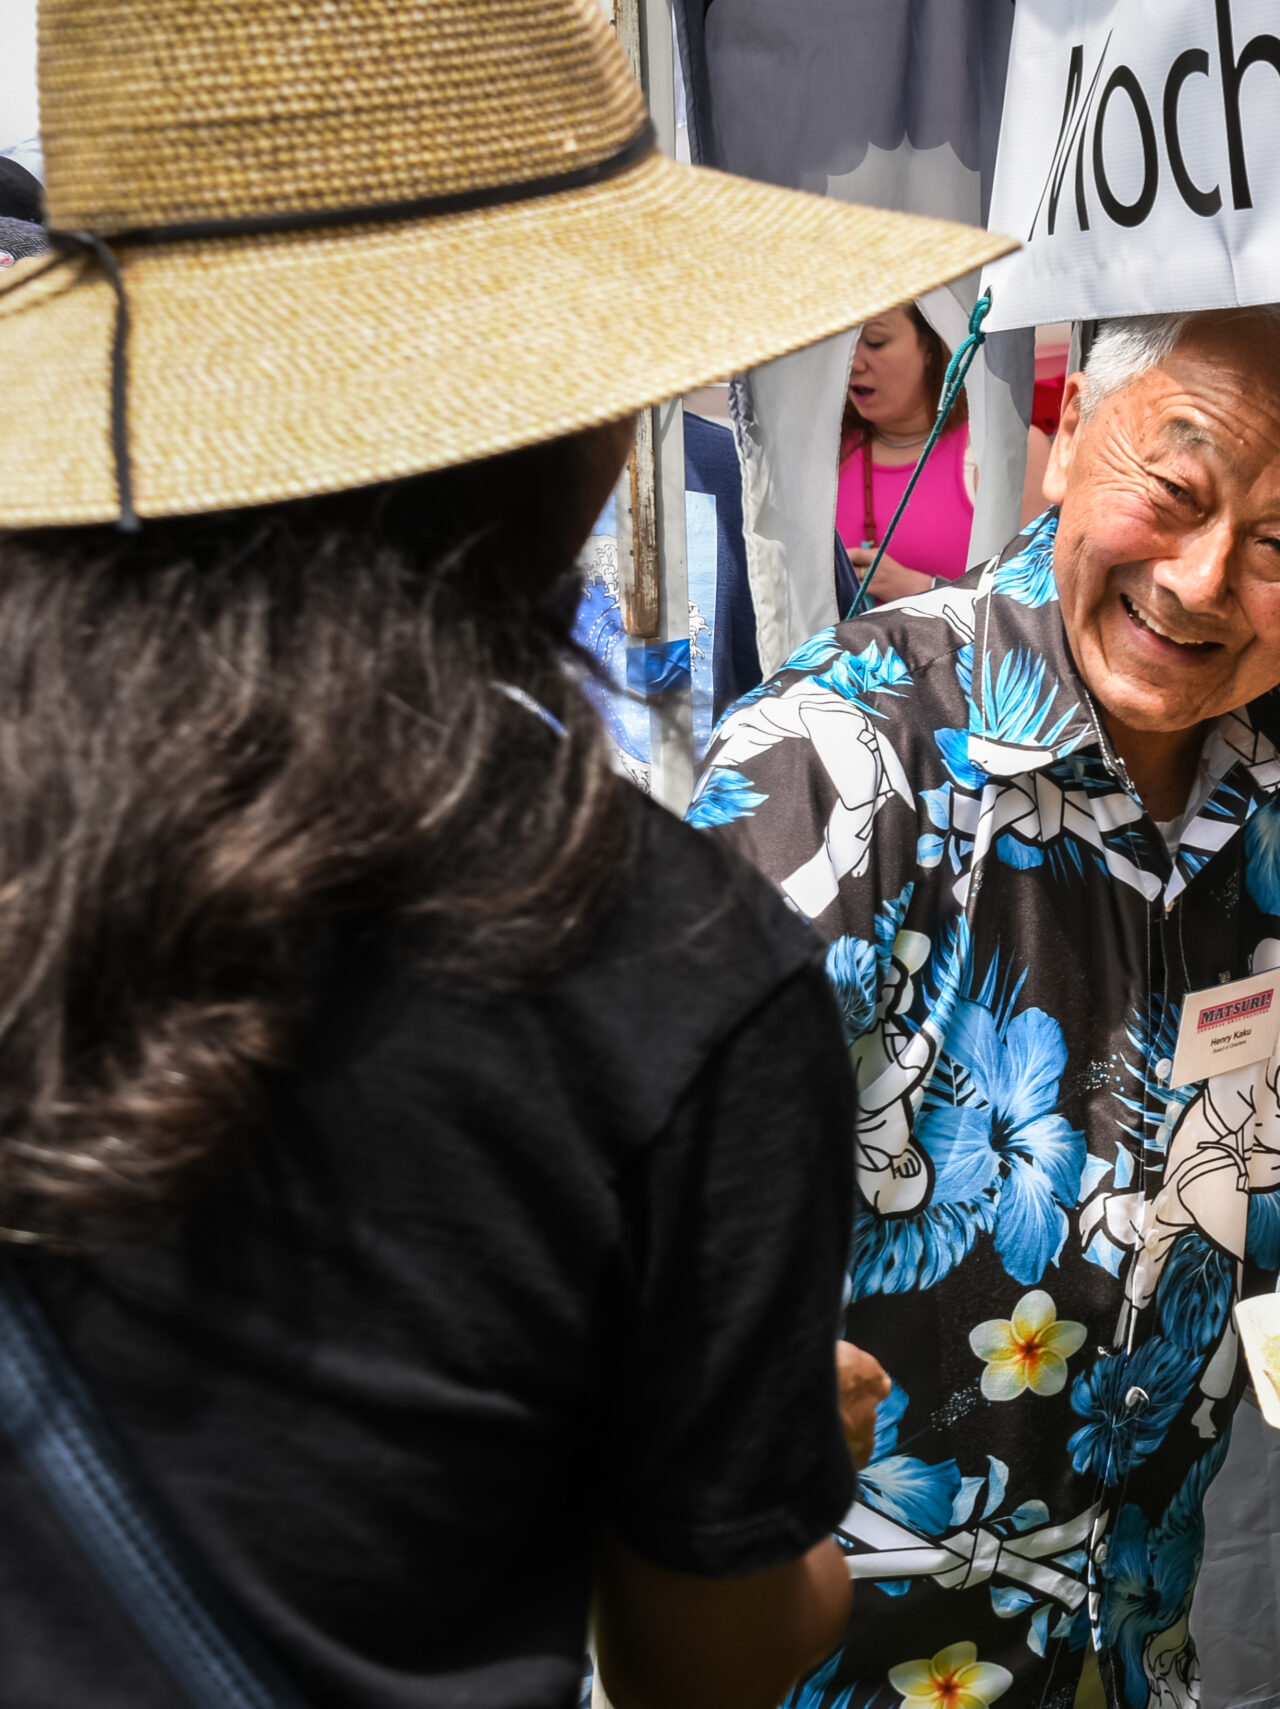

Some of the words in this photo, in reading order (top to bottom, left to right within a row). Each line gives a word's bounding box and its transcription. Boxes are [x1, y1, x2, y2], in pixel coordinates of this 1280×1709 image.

[1200, 993, 1272, 1025] MATSURI!
[1210, 1034, 1232, 1047] Henry
[1233, 1028, 1252, 1040] Kaku
